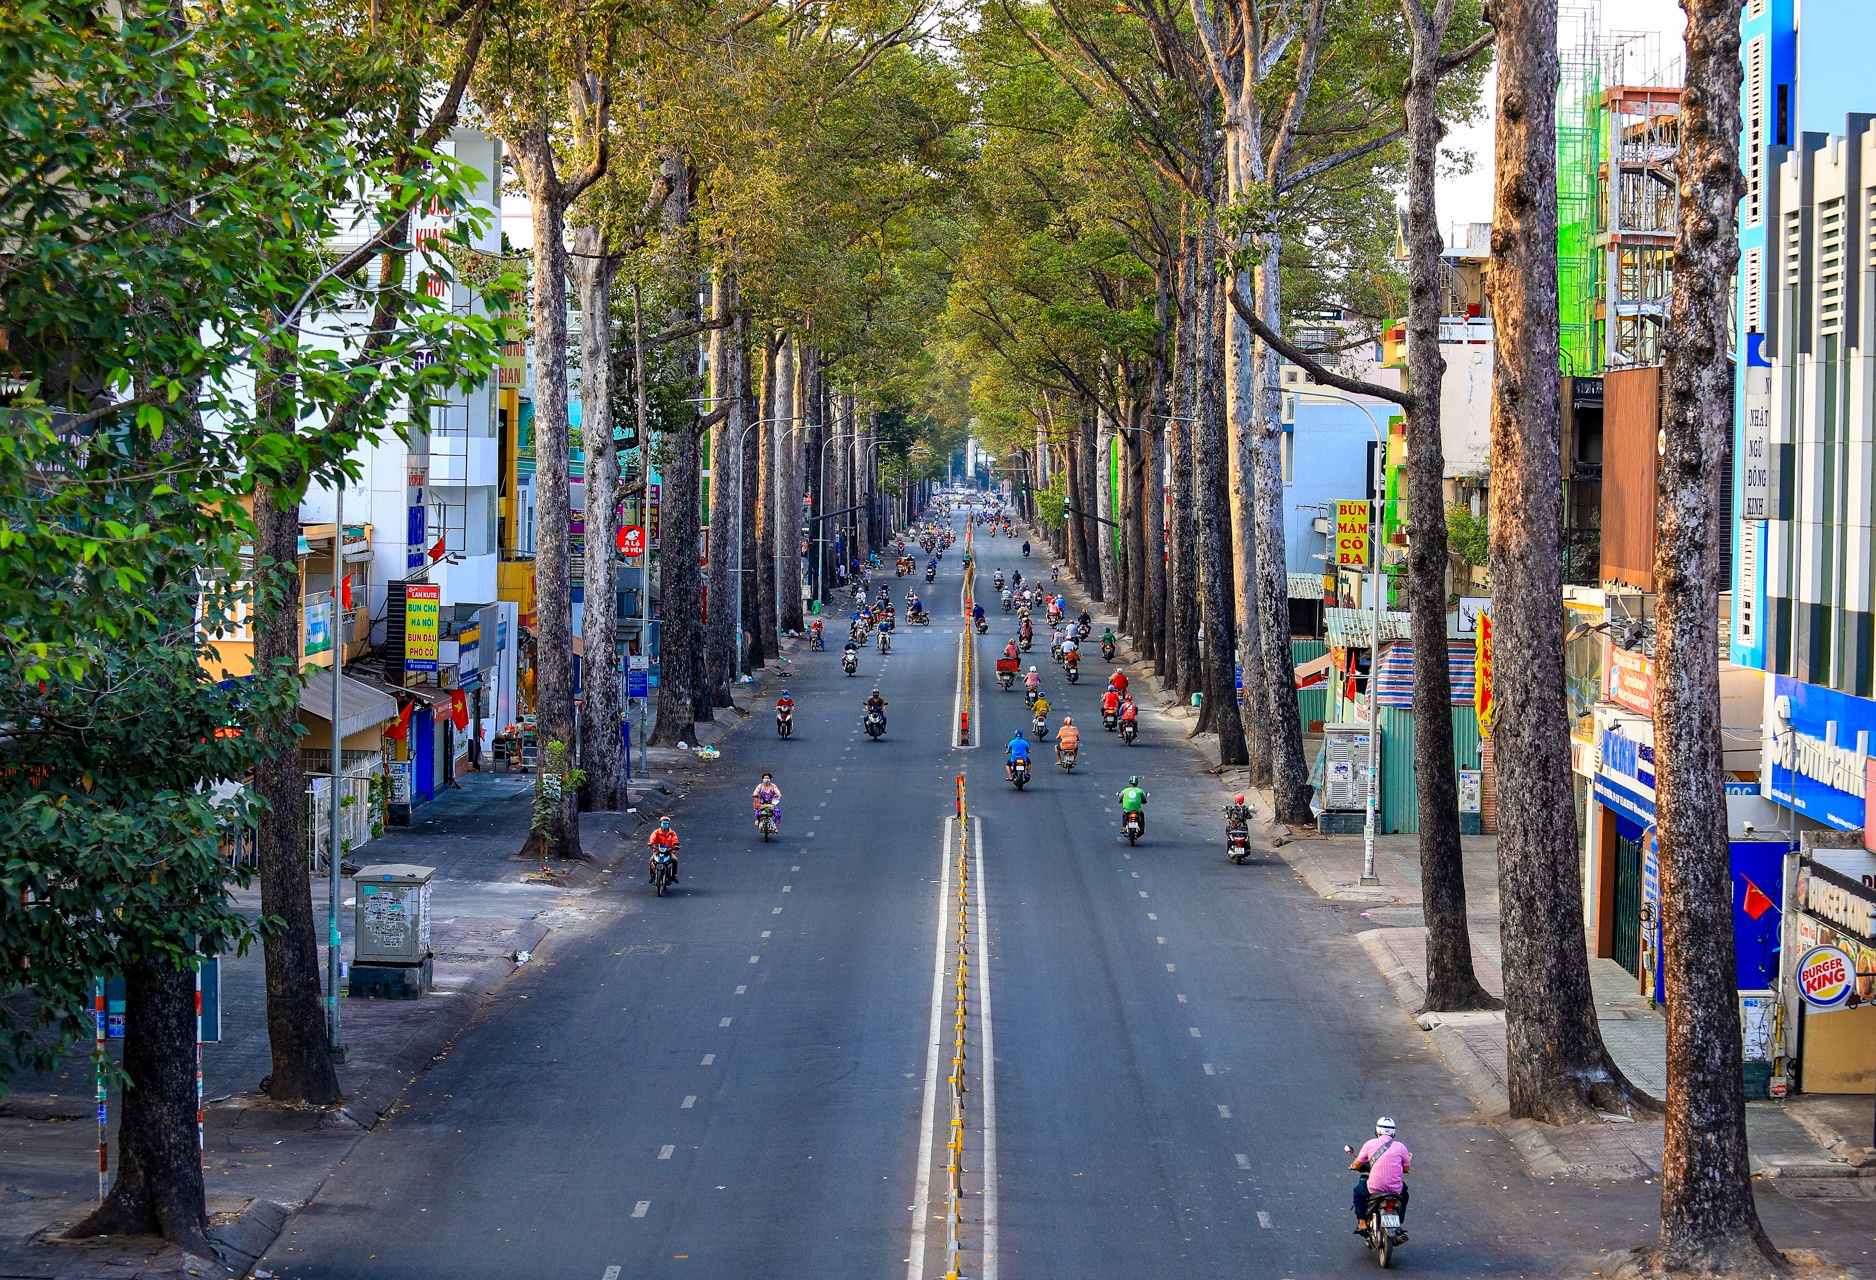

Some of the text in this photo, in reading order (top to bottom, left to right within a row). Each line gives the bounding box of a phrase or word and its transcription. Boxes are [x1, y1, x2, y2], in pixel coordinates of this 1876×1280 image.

[499, 367, 521, 384] GIAN
[1749, 406, 1769, 430] NHẬT
[1749, 436, 1764, 458] NGỮ
[1748, 465, 1767, 487] ĐÔNG
[1339, 502, 1367, 515] BÚN
[1747, 497, 1764, 515] KINH
[1337, 518, 1368, 533] MẮM
[1340, 536, 1364, 550] CÔ
[1339, 553, 1364, 565] BA
[408, 602, 421, 612] BÚN
[407, 631, 421, 642] BÚN
[1772, 695, 1867, 800] Sacombank
[1808, 875, 1848, 927] BURGER
[1847, 889, 1874, 939] KING
[1802, 958, 1843, 982] BURGER
[1805, 967, 1846, 996] KING
